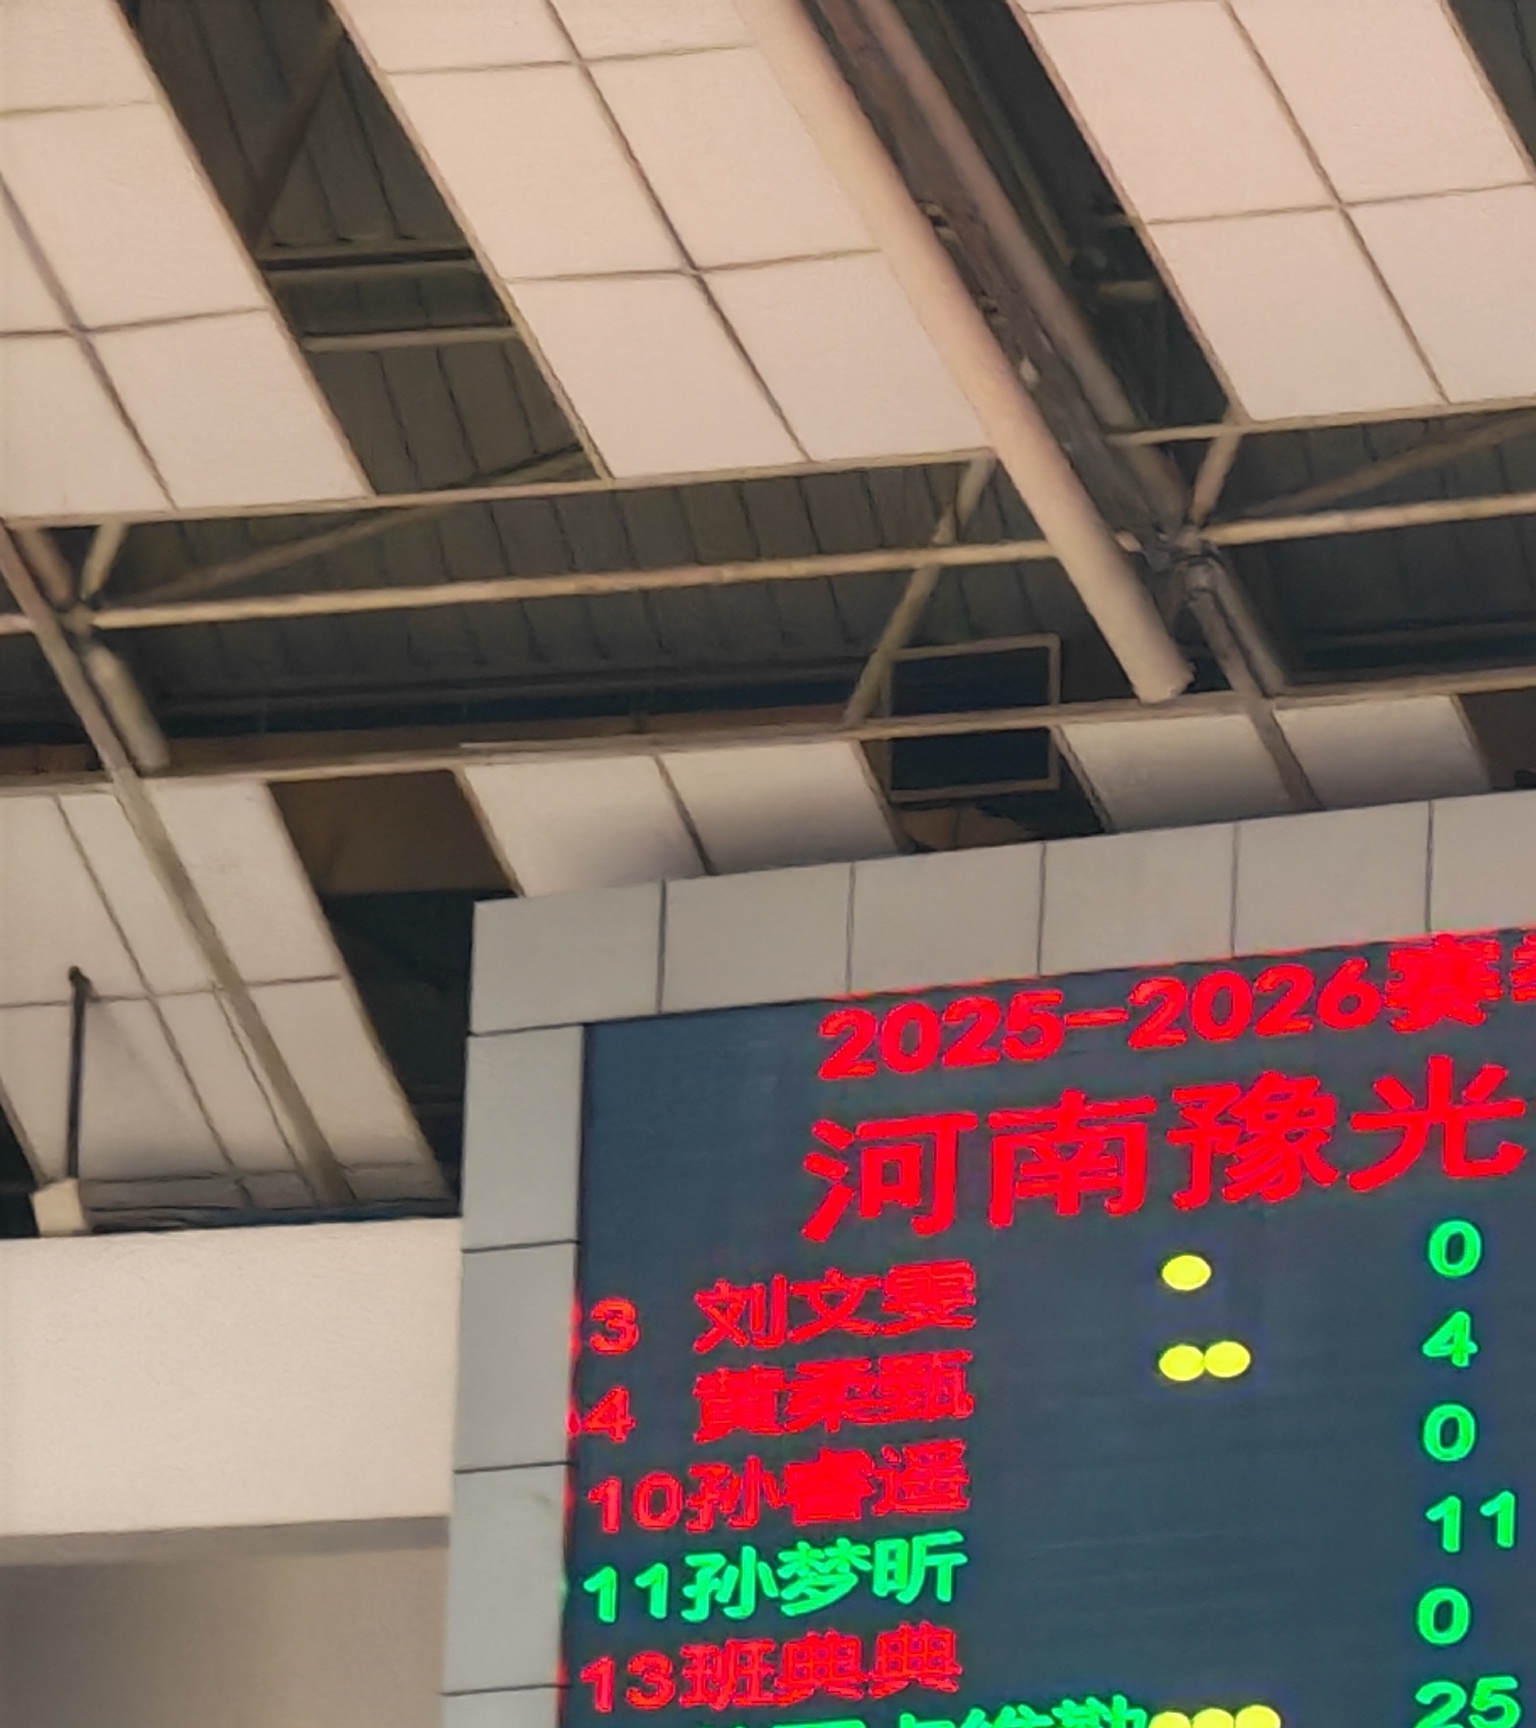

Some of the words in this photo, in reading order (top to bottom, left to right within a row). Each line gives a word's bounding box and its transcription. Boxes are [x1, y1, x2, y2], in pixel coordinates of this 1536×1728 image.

[1427, 1219, 1483, 1278] 0
[588, 1296, 641, 1356] 3
[692, 1258, 977, 1355] 刘文雯
[1421, 1309, 1479, 1369] 4
[583, 1386, 636, 1442] 4
[1422, 1402, 1477, 1463] 0
[1424, 1489, 1516, 1554] 11
[1416, 1586, 1471, 1646] 0
